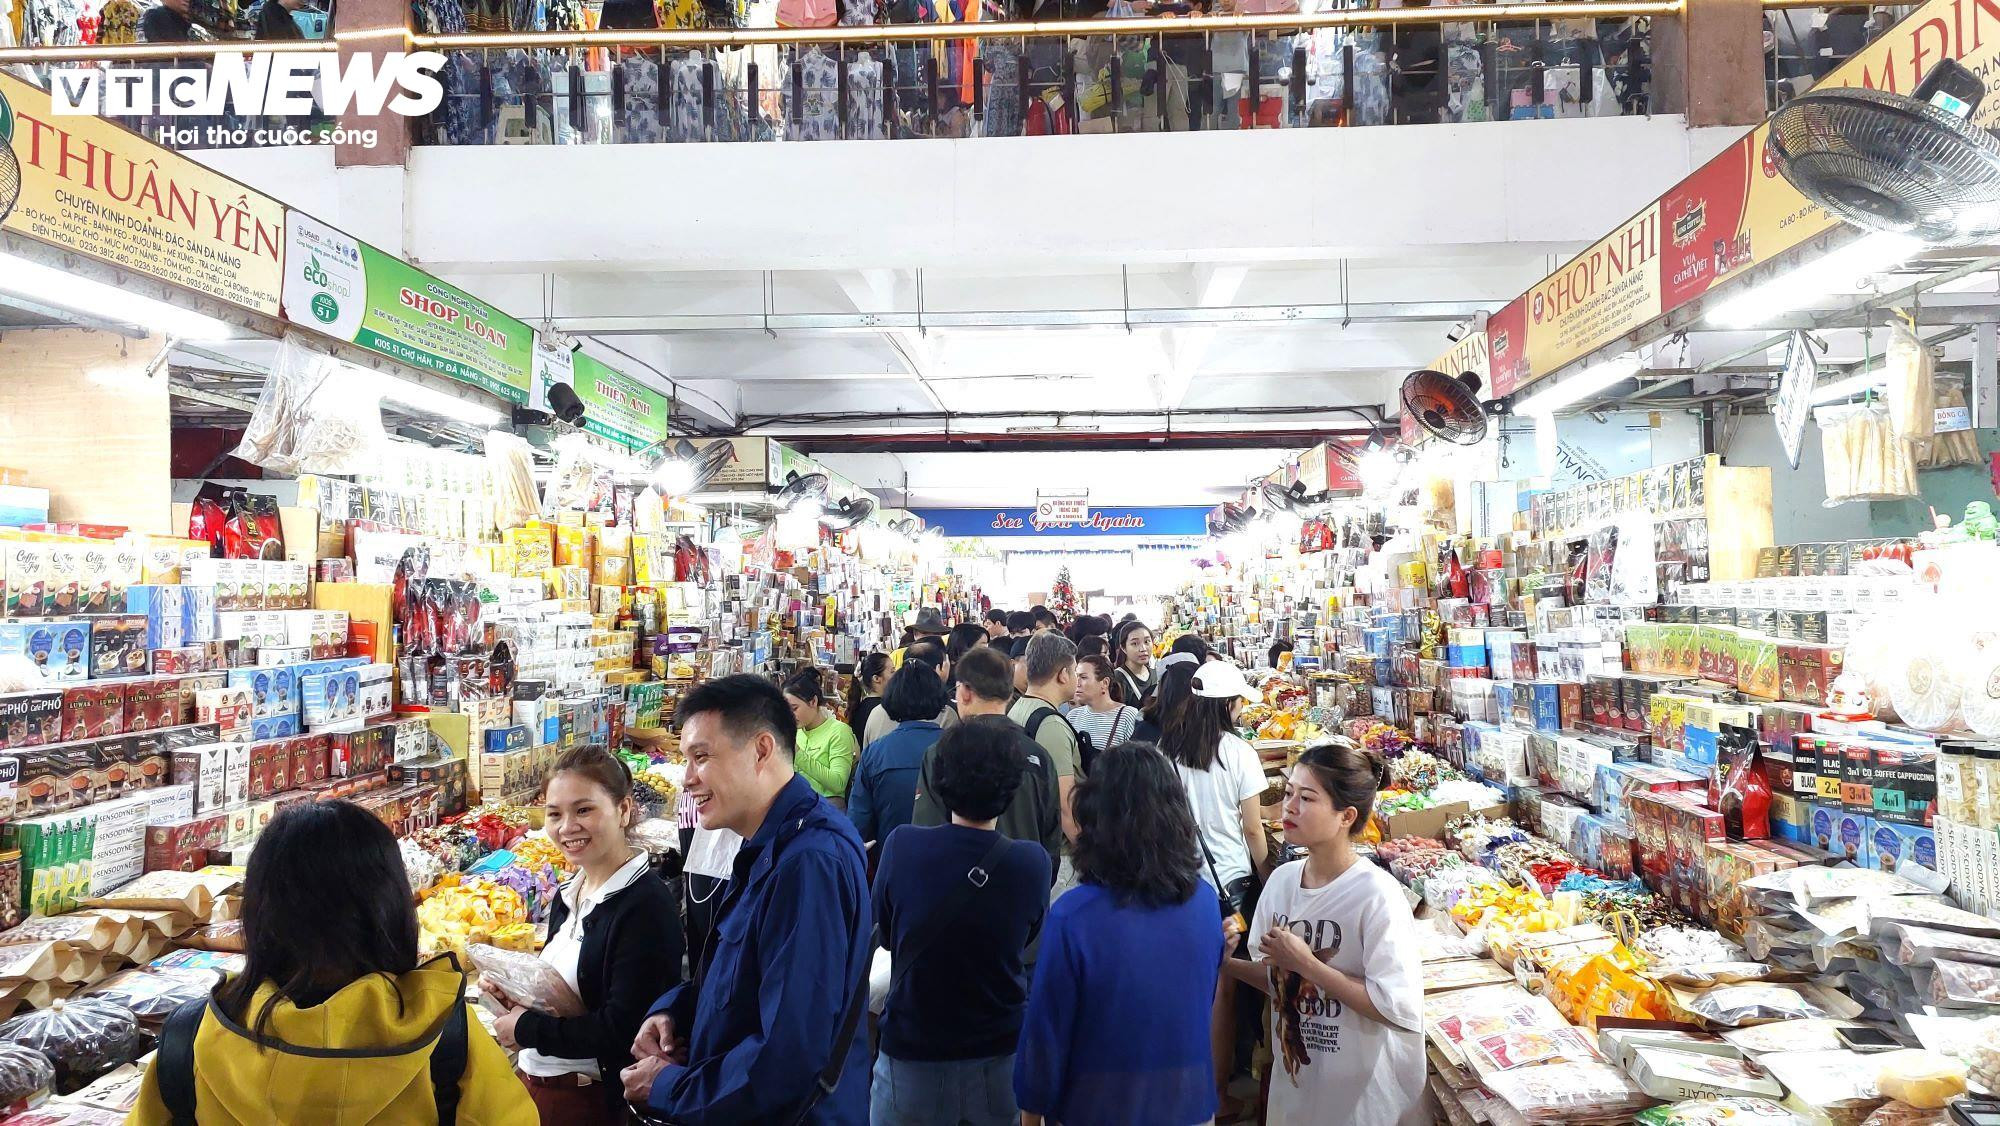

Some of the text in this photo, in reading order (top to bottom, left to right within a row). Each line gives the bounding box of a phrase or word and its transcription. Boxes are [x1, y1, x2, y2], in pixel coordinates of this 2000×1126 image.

[16, 111, 200, 231] THUẬN
[101, 206, 126, 226] KINH
[79, 240, 98, 254] 0236
[1547, 210, 1658, 324] SHOP NHI
[316, 306, 330, 319] 51
[400, 287, 459, 323] SHOP
[464, 315, 508, 350] LOAN
[992, 512, 1024, 529] See
[1078, 511, 1145, 531] Again
[16, 549, 41, 563] Coffee
[7, 698, 29, 715] PHỐ
[41, 697, 62, 711] PHỐ
[69, 701, 91, 709] LUWAK
[1822, 759, 1841, 769] BLAC
[1874, 769, 1897, 779] COFFEE
[99, 807, 135, 823] SENSODYNE
[98, 825, 134, 841] SENSODYNE
[96, 843, 133, 859] SENSODYNE
[96, 861, 133, 878] SENSODYNE
